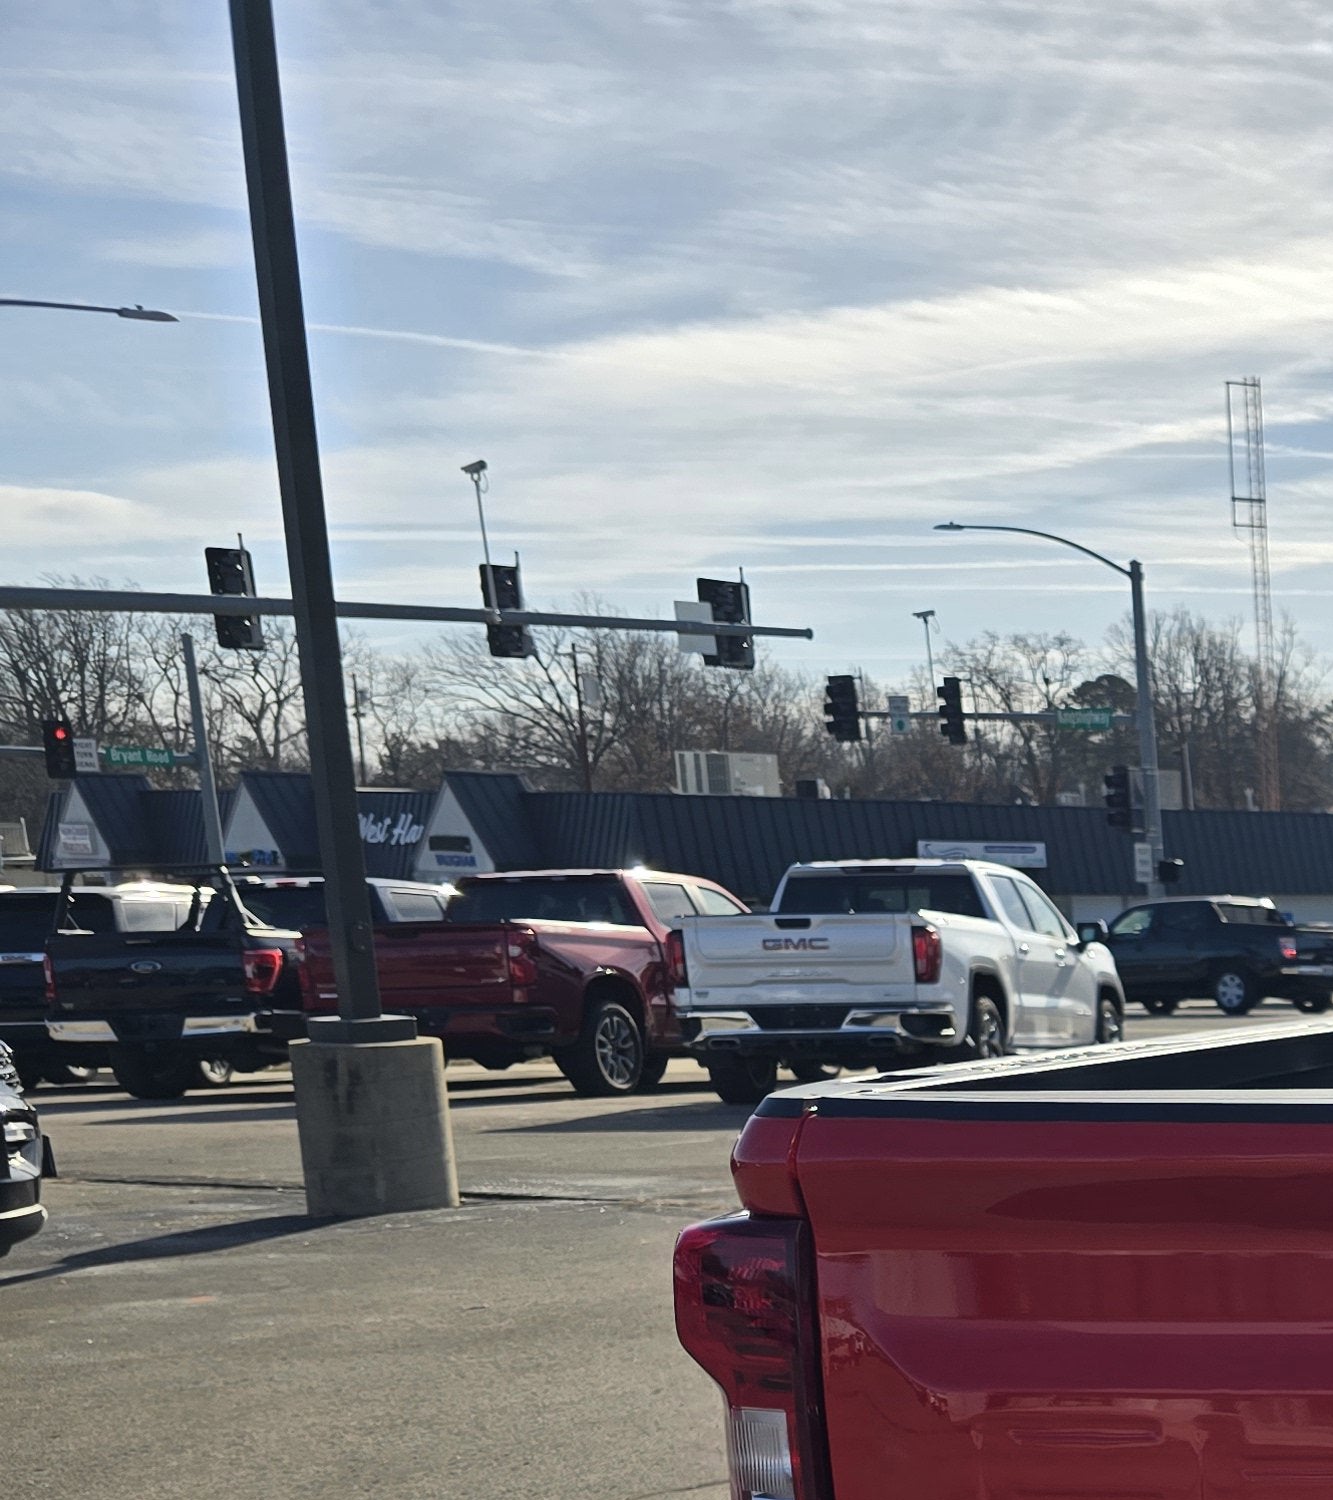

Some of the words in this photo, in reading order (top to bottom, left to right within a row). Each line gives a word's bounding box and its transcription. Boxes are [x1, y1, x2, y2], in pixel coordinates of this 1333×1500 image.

[110, 747, 143, 764] Bryant
[146, 749, 170, 763] Road
[762, 938, 830, 951] GMC
